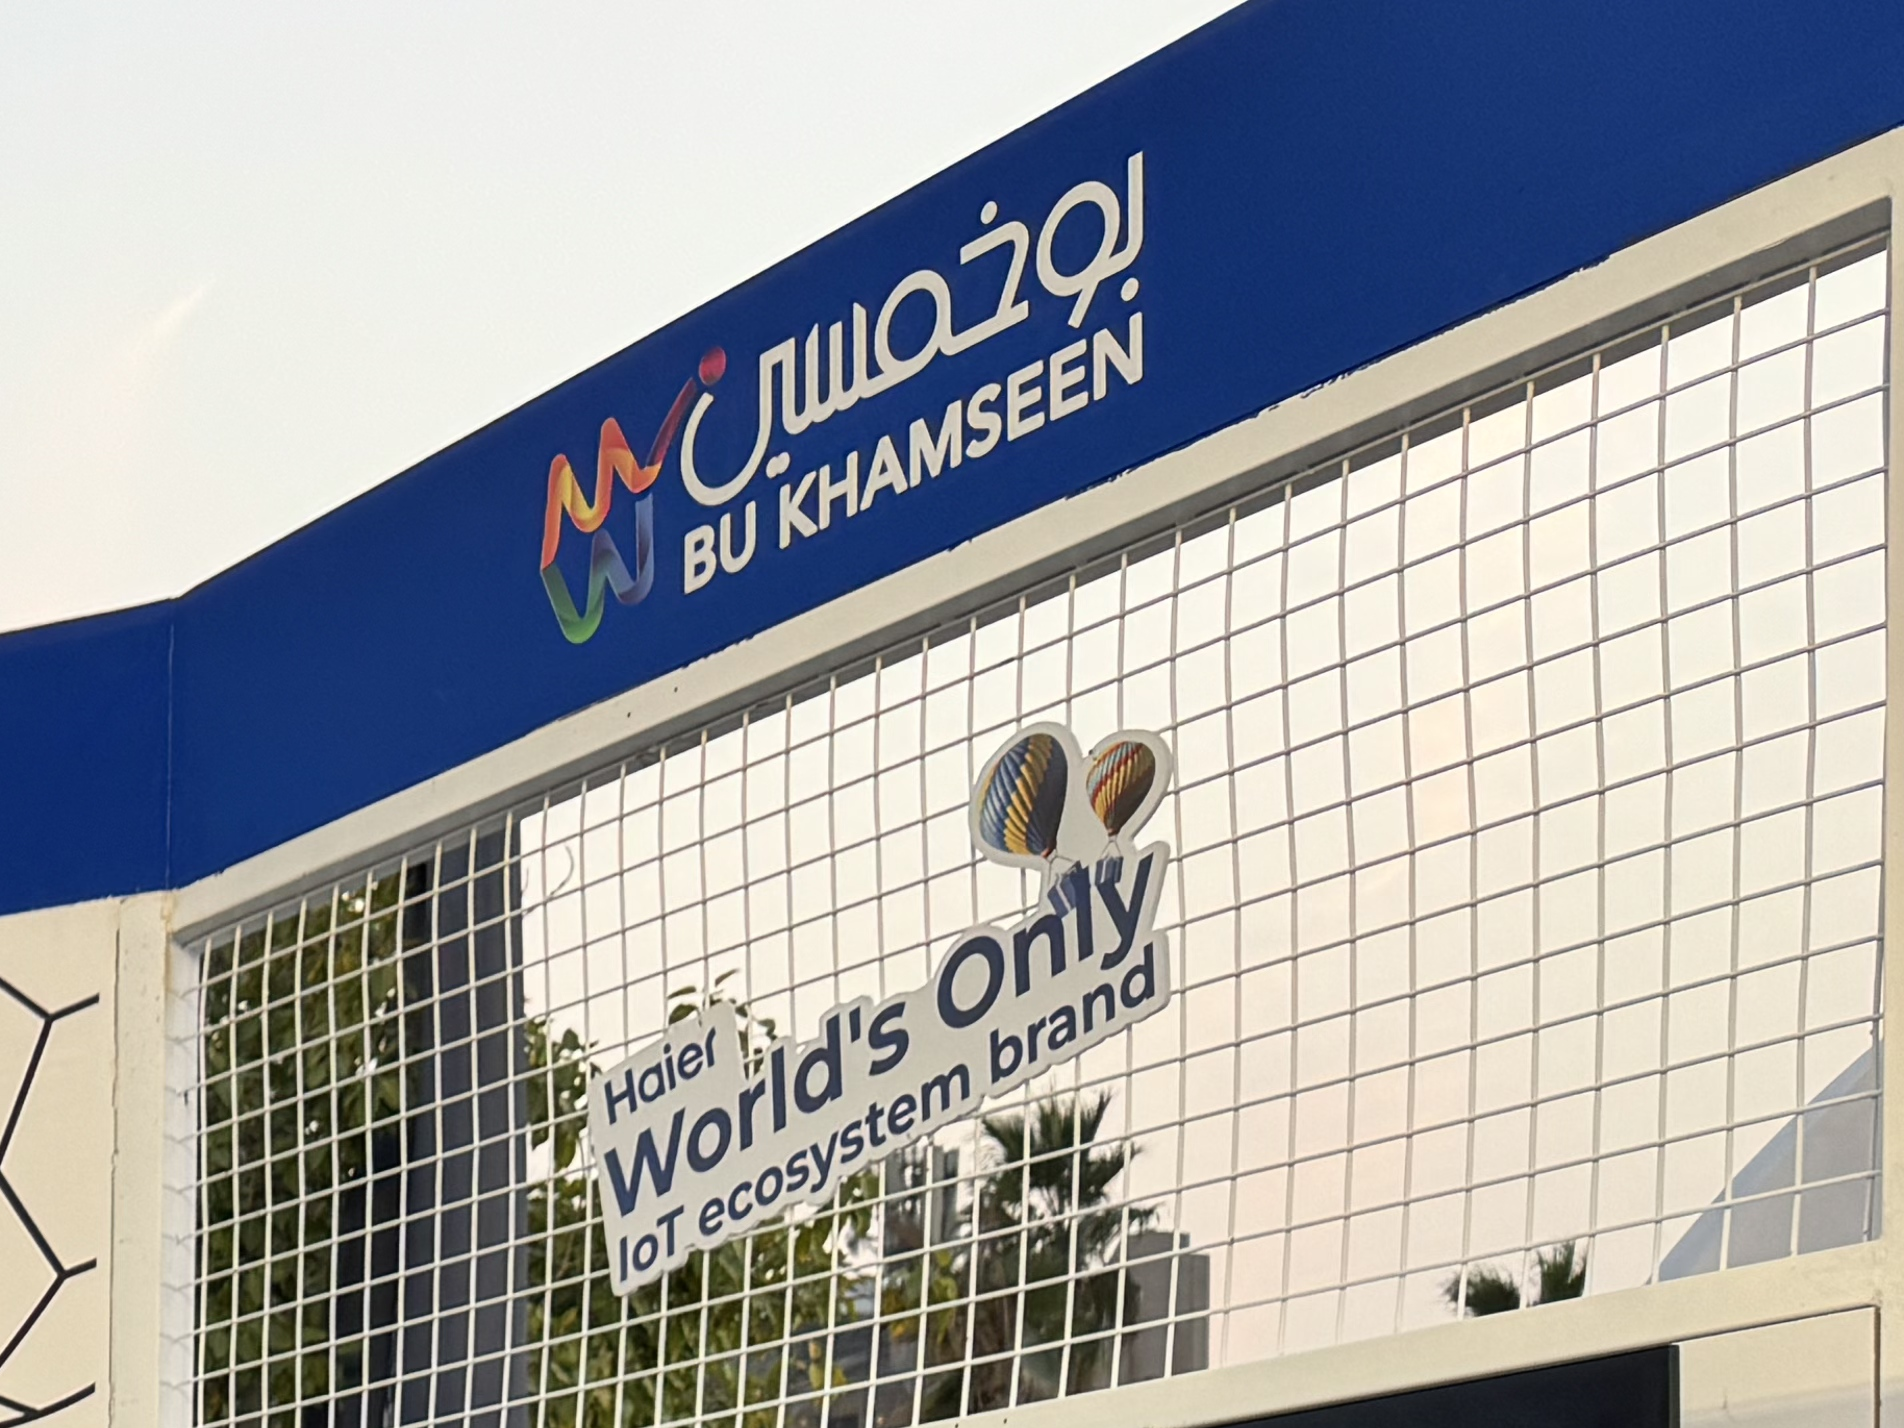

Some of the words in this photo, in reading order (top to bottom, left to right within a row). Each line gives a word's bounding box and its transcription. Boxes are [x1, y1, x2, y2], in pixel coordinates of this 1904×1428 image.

[683, 501, 756, 594] BU
[779, 311, 1143, 548] KHAMSEEN
[603, 1000, 909, 1217] World's
[936, 852, 1154, 1029] Only
[604, 1026, 717, 1124] Haier
[617, 1206, 684, 1281] IoT
[698, 1064, 970, 1236] ecosystem
[989, 942, 1156, 1084] brand
